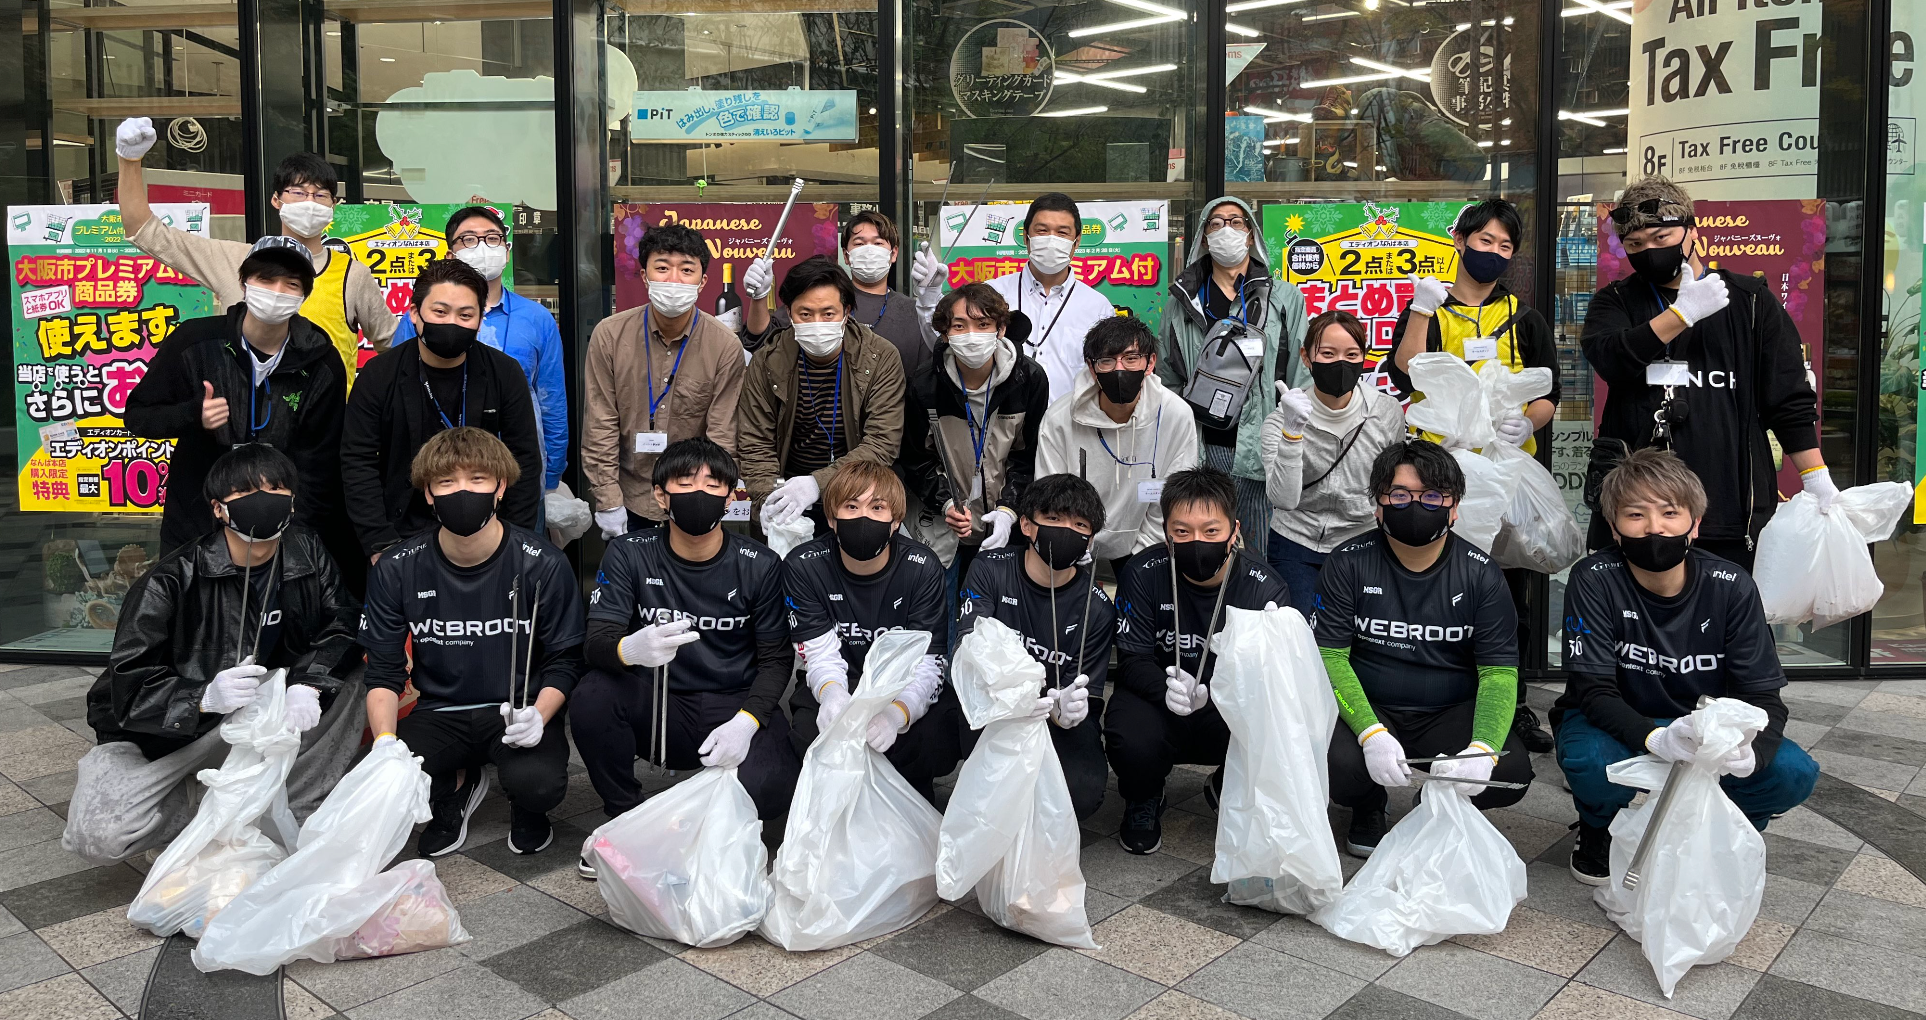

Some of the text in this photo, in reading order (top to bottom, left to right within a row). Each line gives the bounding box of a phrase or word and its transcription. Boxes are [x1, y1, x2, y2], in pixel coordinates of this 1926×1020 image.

[1641, 16, 1914, 106] Tax Fre
[650, 107, 674, 120] PiT
[716, 103, 780, 128] 色で確認
[1679, 140, 1710, 160] Tax
[1719, 135, 1768, 156] Free
[1795, 158, 1812, 166] Free
[184, 189, 213, 198] ミニカード
[23, 290, 67, 305] スマホアプリ
[75, 280, 137, 302] 商品券
[18, 364, 100, 383] 当店で使うと
[27, 388, 101, 418] さらに
[51, 440, 175, 459] エディオンポイント
[30, 459, 67, 468] なんば本店
[31, 468, 68, 477] 購入限定
[33, 481, 70, 500] 特典
[80, 484, 98, 494] 最大
[522, 542, 542, 557] intel
[739, 546, 758, 559] intel
[1467, 549, 1490, 564] intel
[907, 553, 928, 565] intel
[1248, 568, 1268, 583] intel
[1712, 570, 1738, 582] intel
[1354, 614, 1475, 642] WEBROOT
[1386, 640, 1416, 652] company
[1334, 689, 1355, 715] ARMOUR
